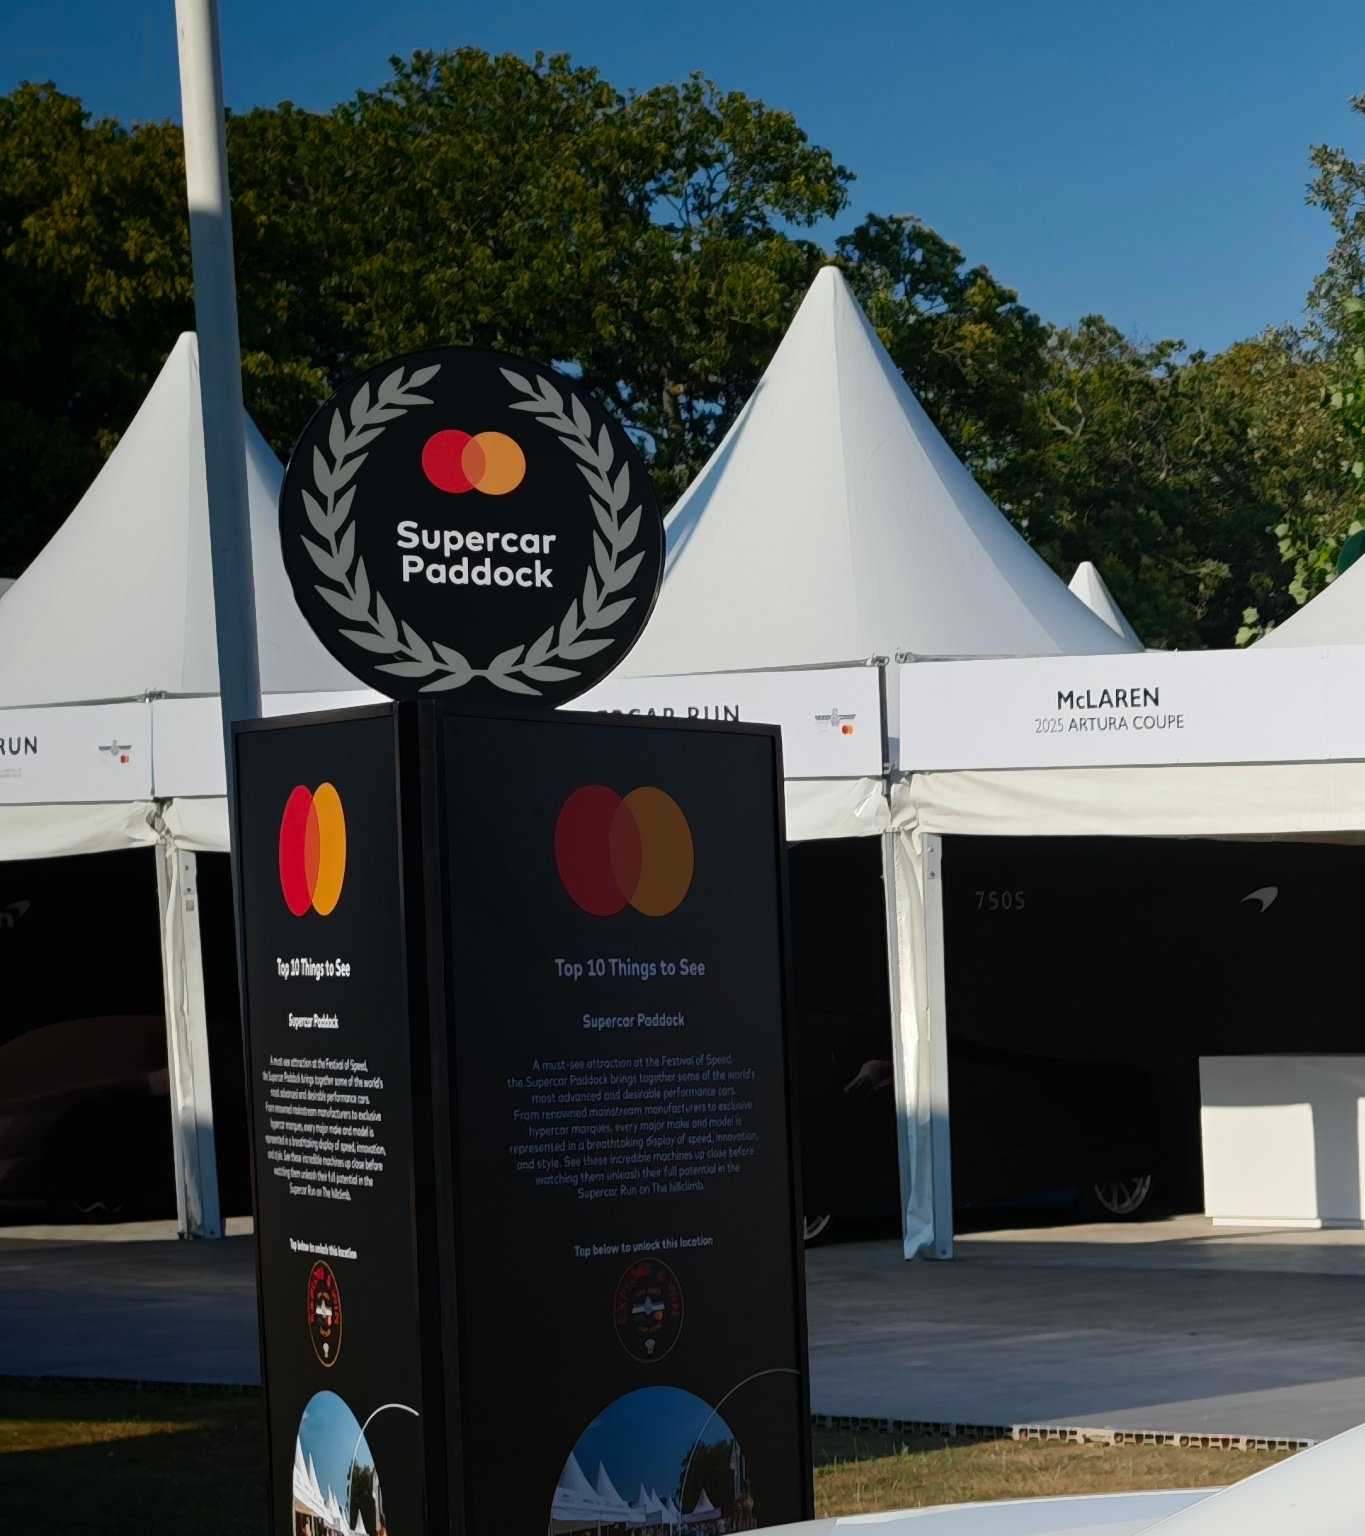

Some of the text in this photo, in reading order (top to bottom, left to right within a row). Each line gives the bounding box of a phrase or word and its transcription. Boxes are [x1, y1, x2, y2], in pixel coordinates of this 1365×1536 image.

[396, 520, 557, 558] Supercar
[402, 554, 554, 589] Paddock
[1057, 686, 1160, 711] McLAREN
[1034, 714, 1185, 734] 2025 ARTURA COUPE
[974, 890, 1026, 911] 750S
[276, 957, 352, 981] Top 10 Things to See
[555, 957, 706, 982] Top 10 Things to See
[582, 1011, 686, 1031] Supercar Paddock
